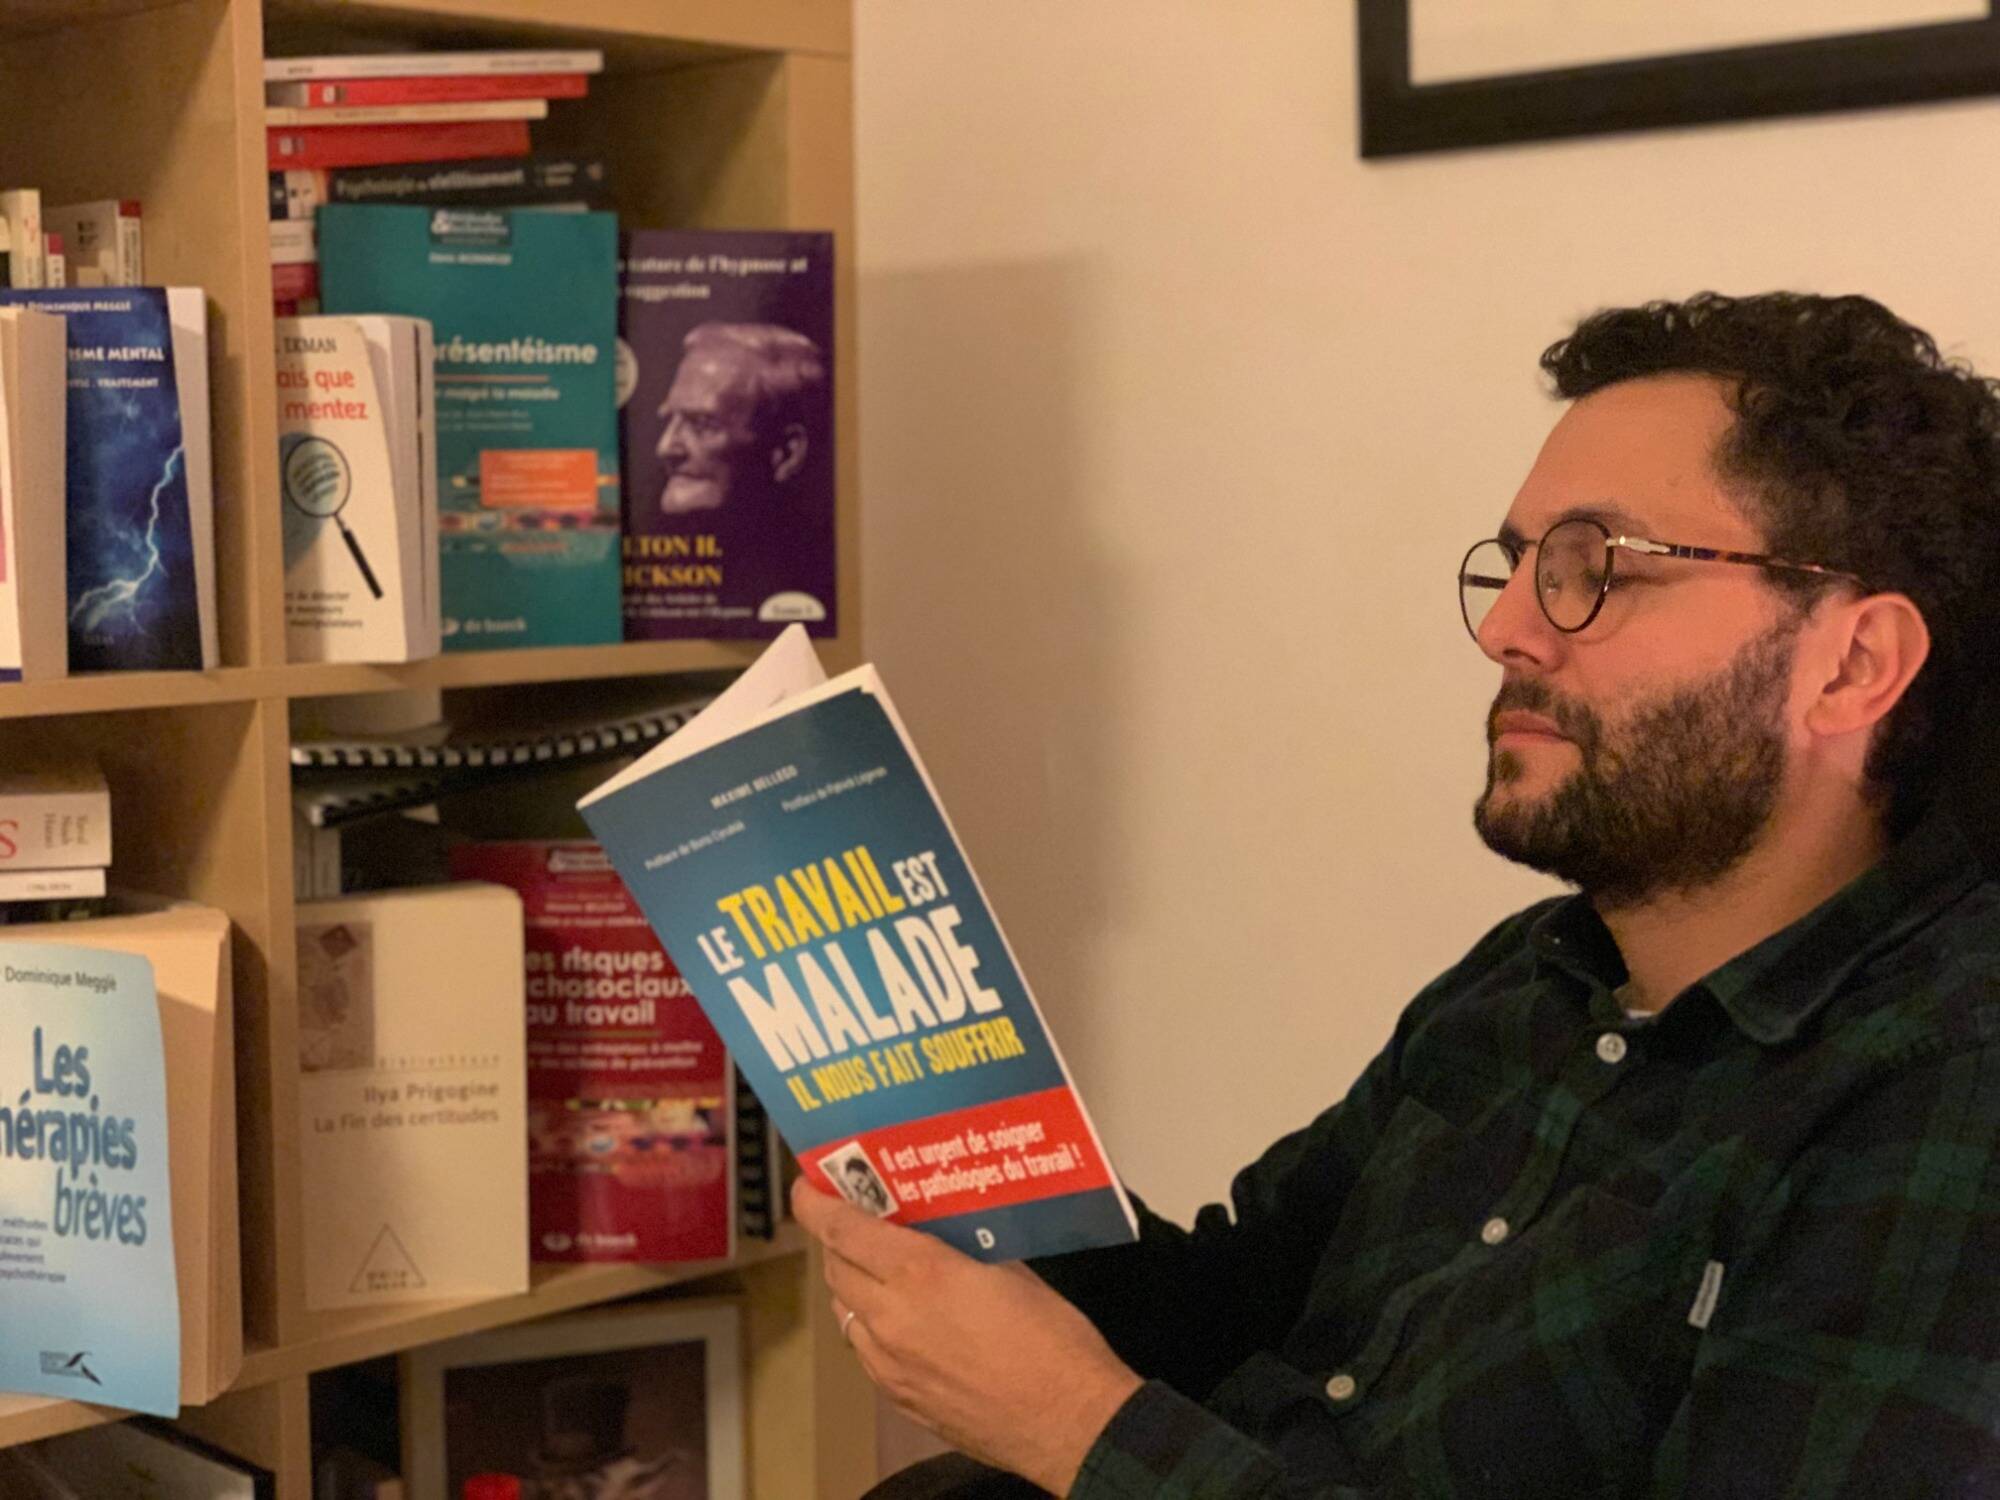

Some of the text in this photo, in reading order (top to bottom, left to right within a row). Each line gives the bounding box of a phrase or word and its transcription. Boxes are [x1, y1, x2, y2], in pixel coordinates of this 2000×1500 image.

[68, 346, 165, 361] ISME MENTAL
[433, 335, 599, 365] résentéisme
[276, 362, 355, 394] ais que
[284, 397, 369, 420] mentez
[623, 565, 722, 587] ICKSON
[697, 845, 949, 976] LE TRAVAIL EST
[5, 966, 72, 987] Dominique
[526, 946, 665, 977] es risques
[528, 972, 693, 998] chosociaux
[726, 904, 1004, 1073] MALADE
[565, 1000, 656, 1025] travail
[33, 1025, 91, 1099] Les
[786, 1015, 1026, 1112] IL NOUS FAIT SOUFFRIR
[364, 1081, 500, 1106] Ilya Prigogine
[0, 1088, 138, 1177] hérapies
[313, 1116, 335, 1134] La
[371, 1109, 404, 1129] des
[408, 1106, 500, 1127] certitudes
[893, 1144, 920, 1172] est
[918, 1134, 970, 1169] urgent
[966, 1128, 990, 1155] de
[987, 1120, 1046, 1154] soigner
[892, 1178, 922, 1203] les
[918, 1160, 1006, 1204] pathologies
[1002, 1153, 1027, 1182] du
[1022, 1141, 1076, 1178] travail
[53, 1168, 148, 1247] brèves
